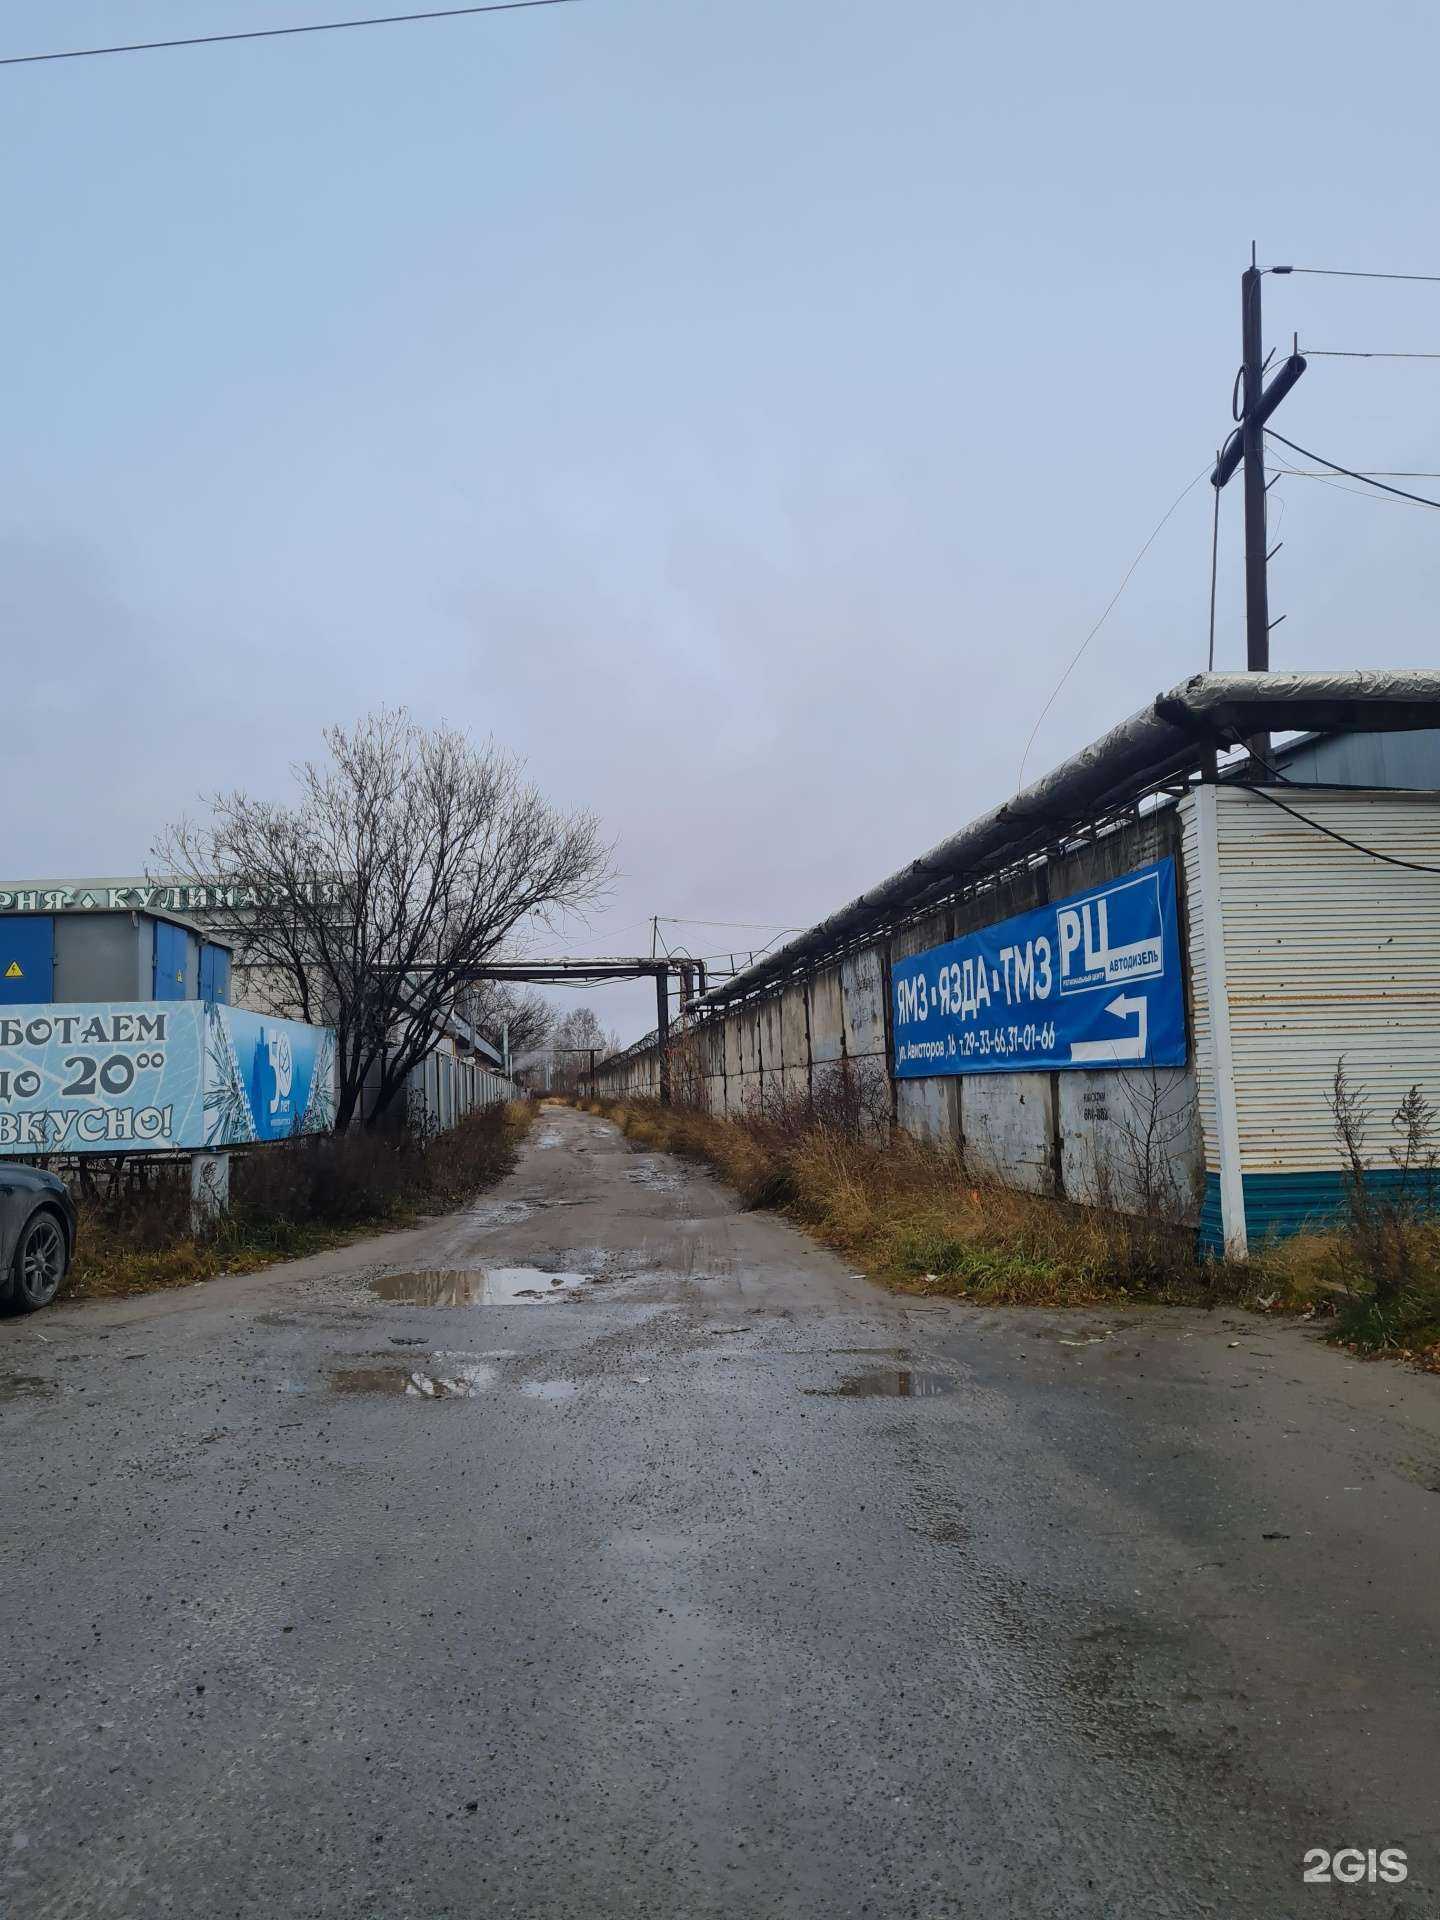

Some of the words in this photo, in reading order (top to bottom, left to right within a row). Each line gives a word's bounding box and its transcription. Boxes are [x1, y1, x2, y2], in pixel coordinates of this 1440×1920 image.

[1109, 949, 1159, 973] АВТОДИЗЕЛЬ
[939, 955, 991, 1021] ЯЗДА
[1000, 936, 1053, 1006] ТМЗ
[0, 1014, 166, 1046] БОТАЕМ
[907, 1039, 945, 1063] Авиаторов
[0, 1103, 174, 1145] ВКУСНО!
